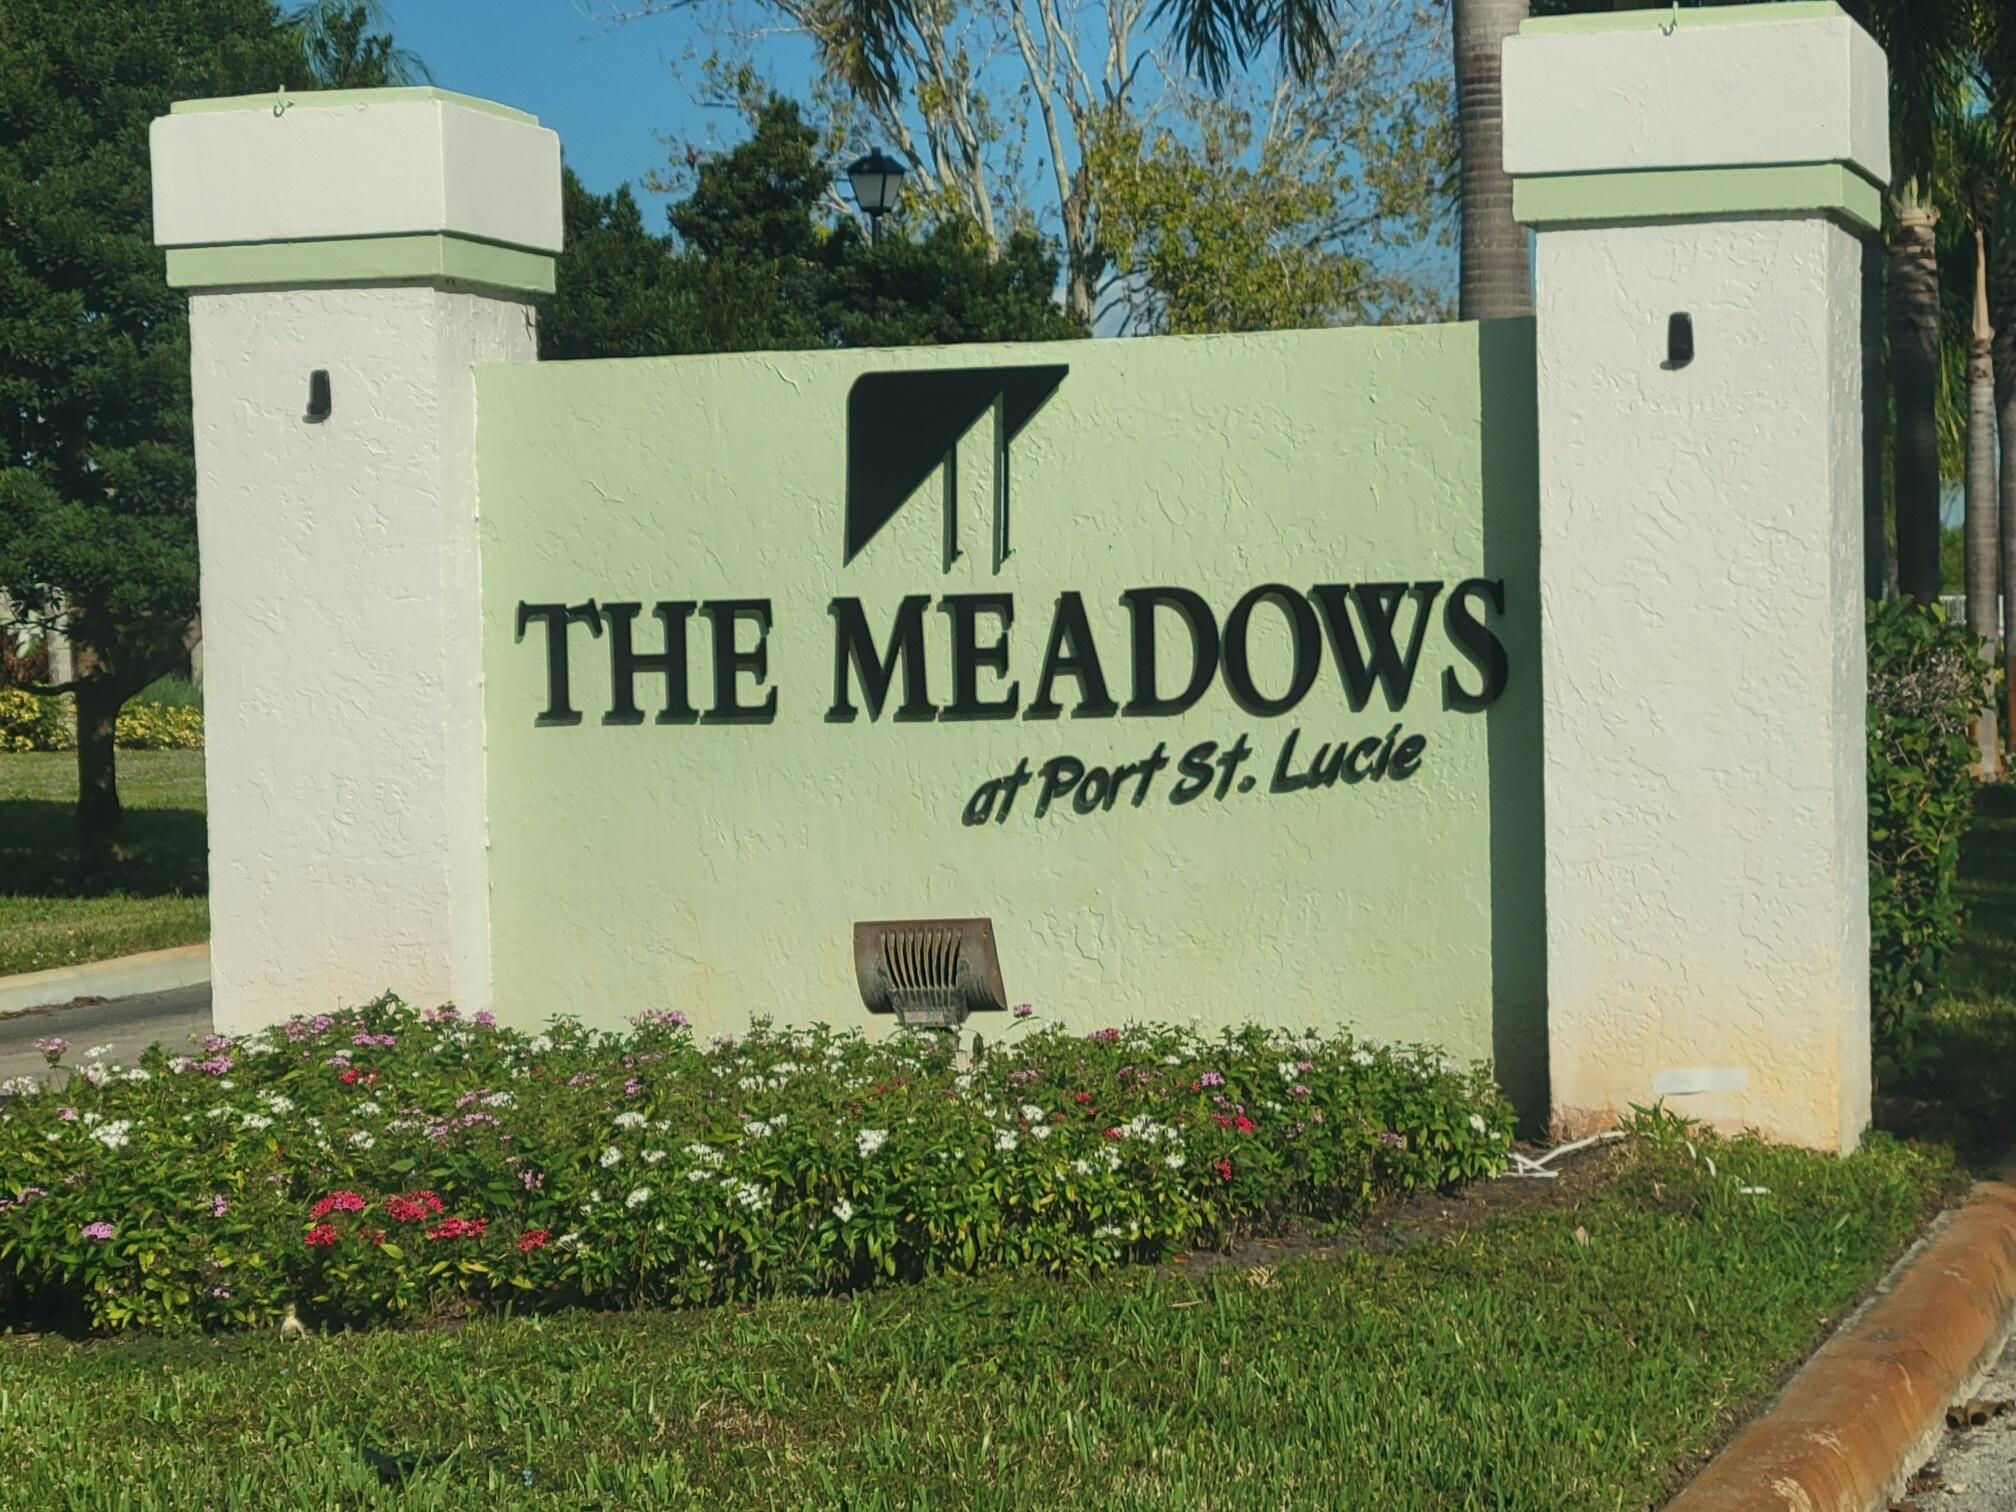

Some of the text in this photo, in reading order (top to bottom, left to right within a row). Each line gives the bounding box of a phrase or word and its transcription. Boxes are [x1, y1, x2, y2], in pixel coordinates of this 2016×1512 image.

[517, 578, 1508, 726] THE MEADOWS
[962, 723, 1427, 826] at Port St. Lucie
